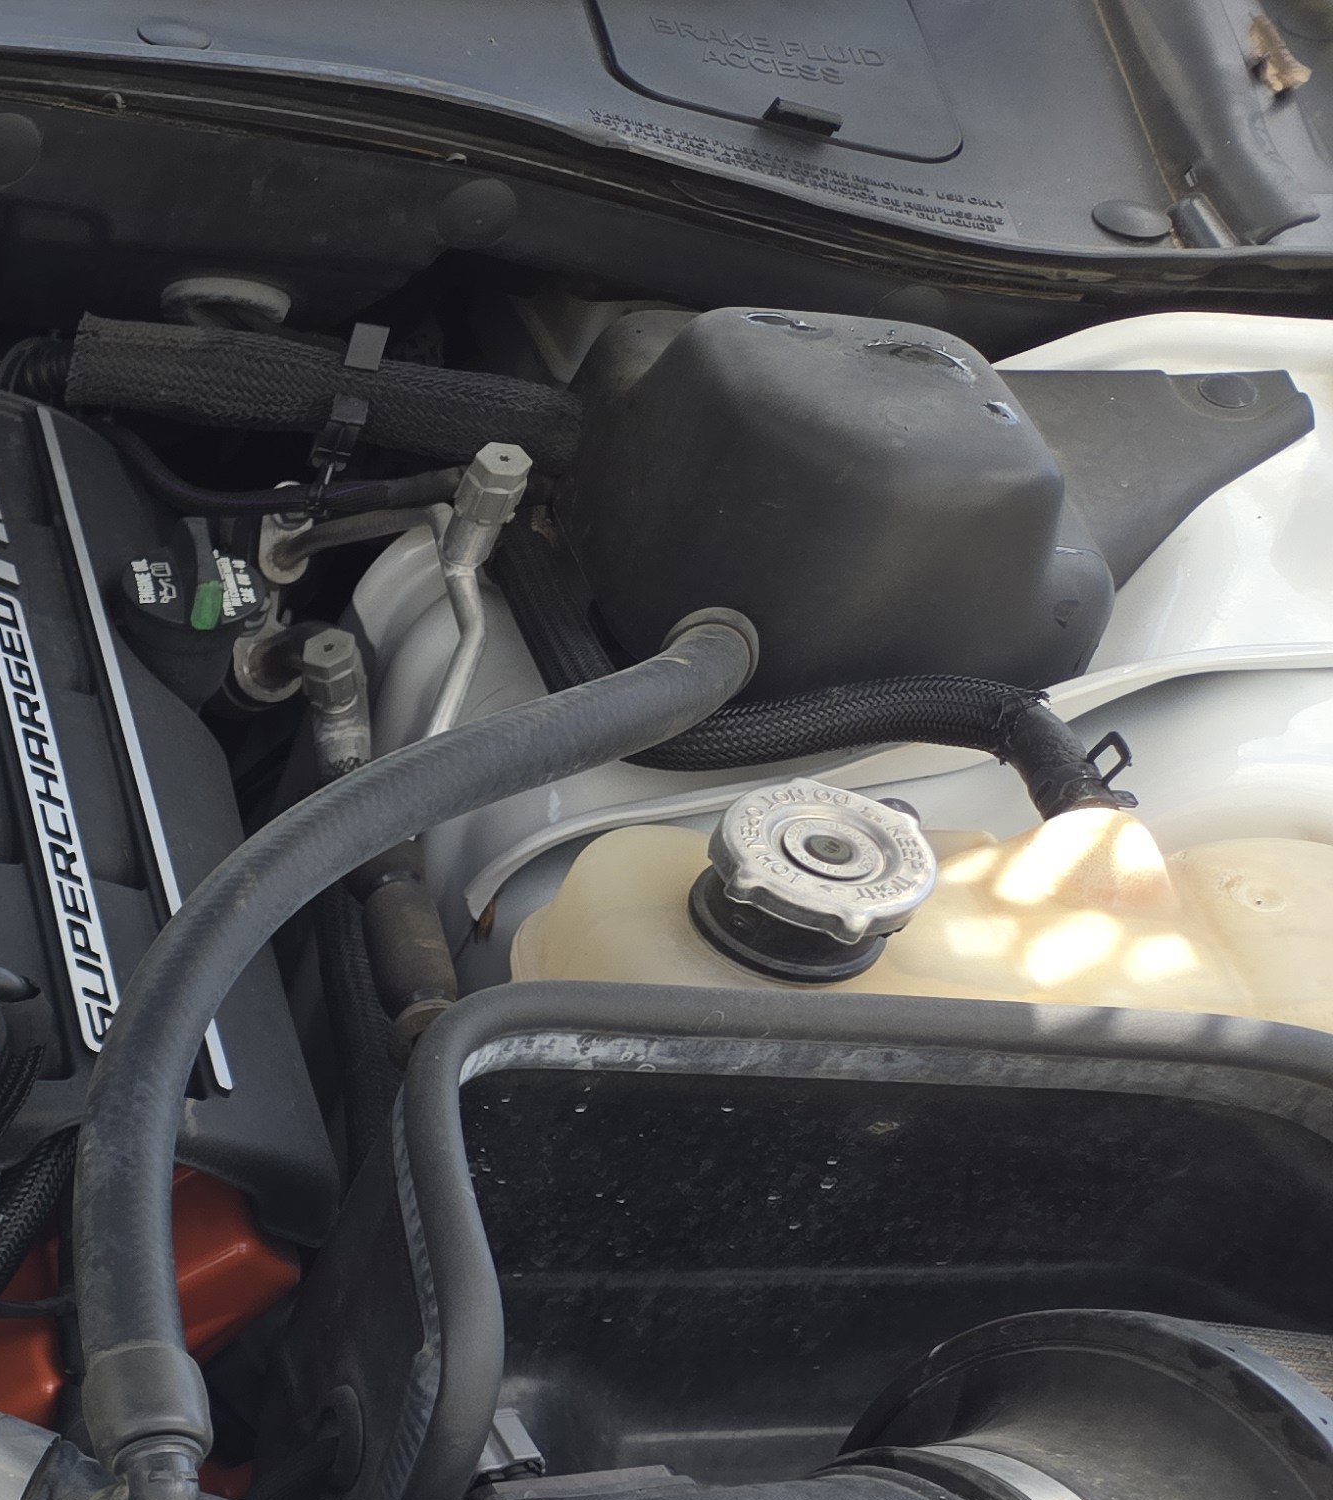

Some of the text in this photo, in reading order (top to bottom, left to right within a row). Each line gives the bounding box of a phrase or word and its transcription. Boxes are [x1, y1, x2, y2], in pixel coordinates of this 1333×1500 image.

[649, 16, 885, 67] BRAKE FLUID
[701, 47, 846, 85] ACCESS
[855, 823, 926, 902] KEEP TIGHT
